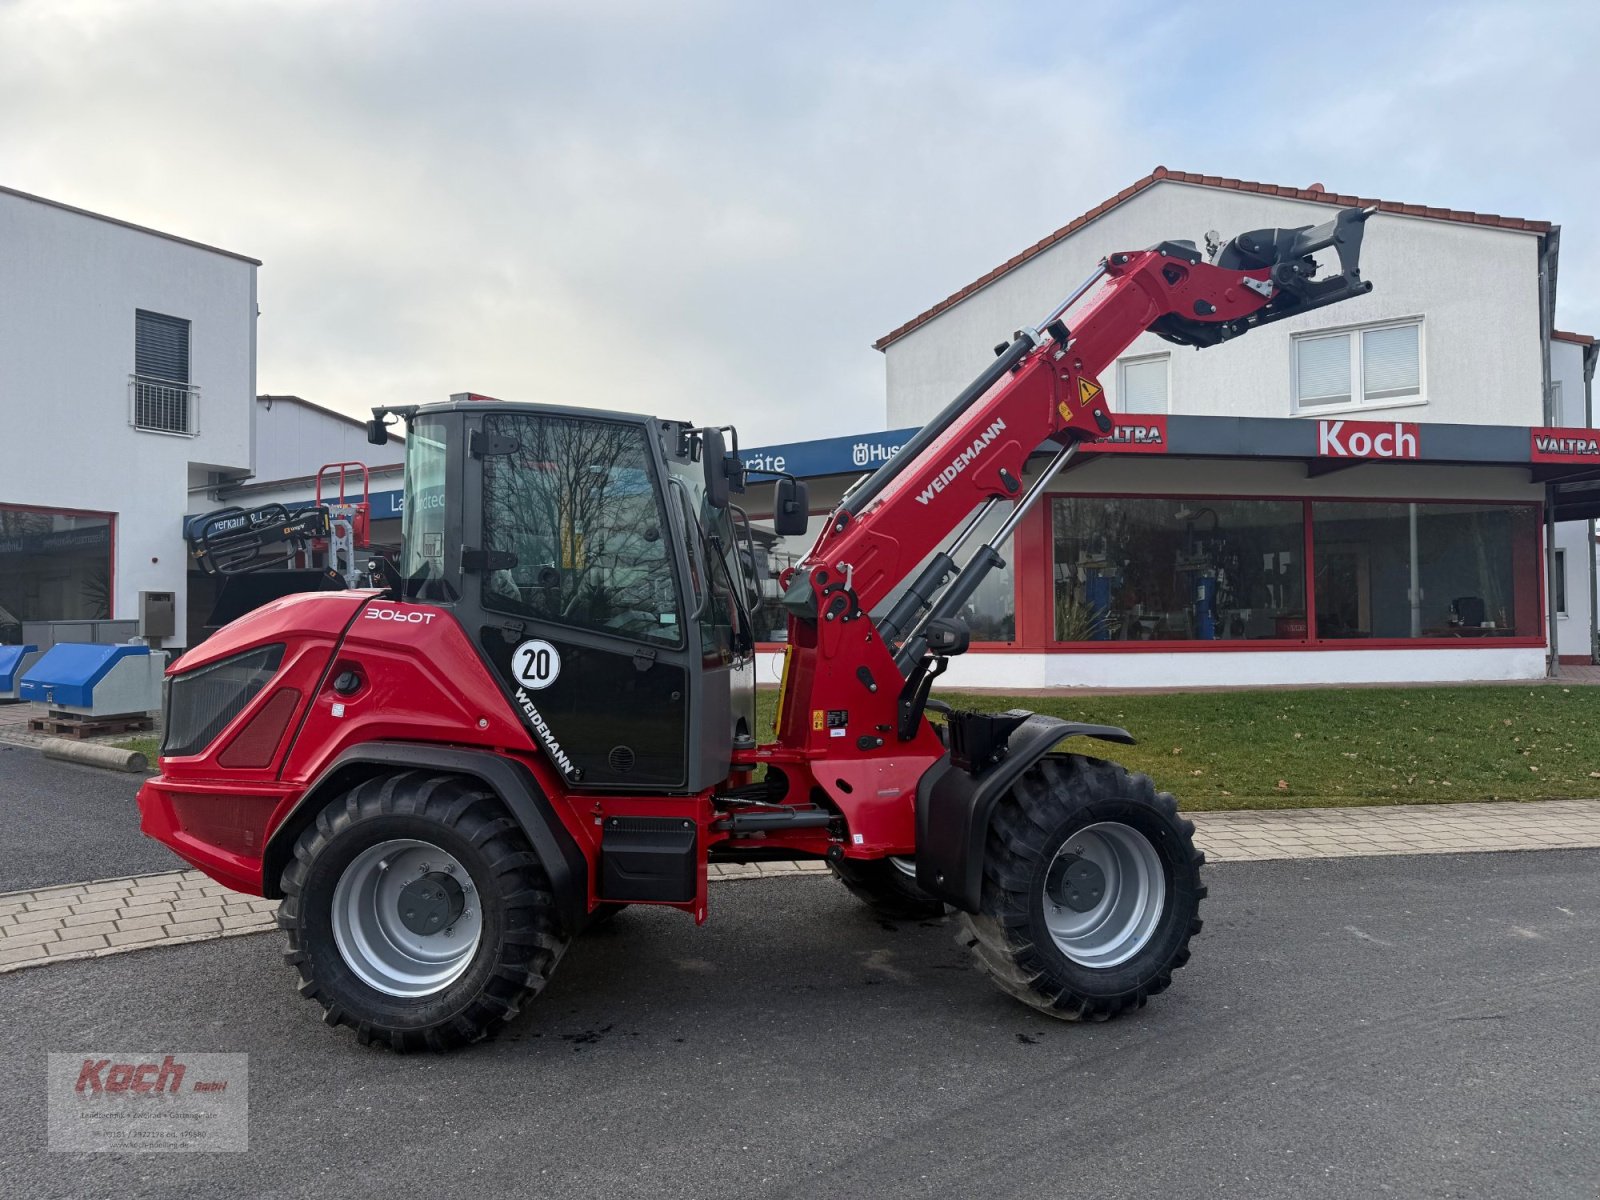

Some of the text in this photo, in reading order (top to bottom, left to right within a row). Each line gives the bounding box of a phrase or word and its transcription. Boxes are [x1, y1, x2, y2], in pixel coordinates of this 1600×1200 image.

[1096, 426, 1162, 443] LTRA
[1319, 420, 1416, 457] Koch
[1534, 435, 1600, 455] VALTRA
[915, 417, 1006, 505] WEIDEMANN
[365, 607, 436, 624] 3060T
[522, 648, 550, 680] 20
[515, 686, 574, 774] WEIDEMANN
